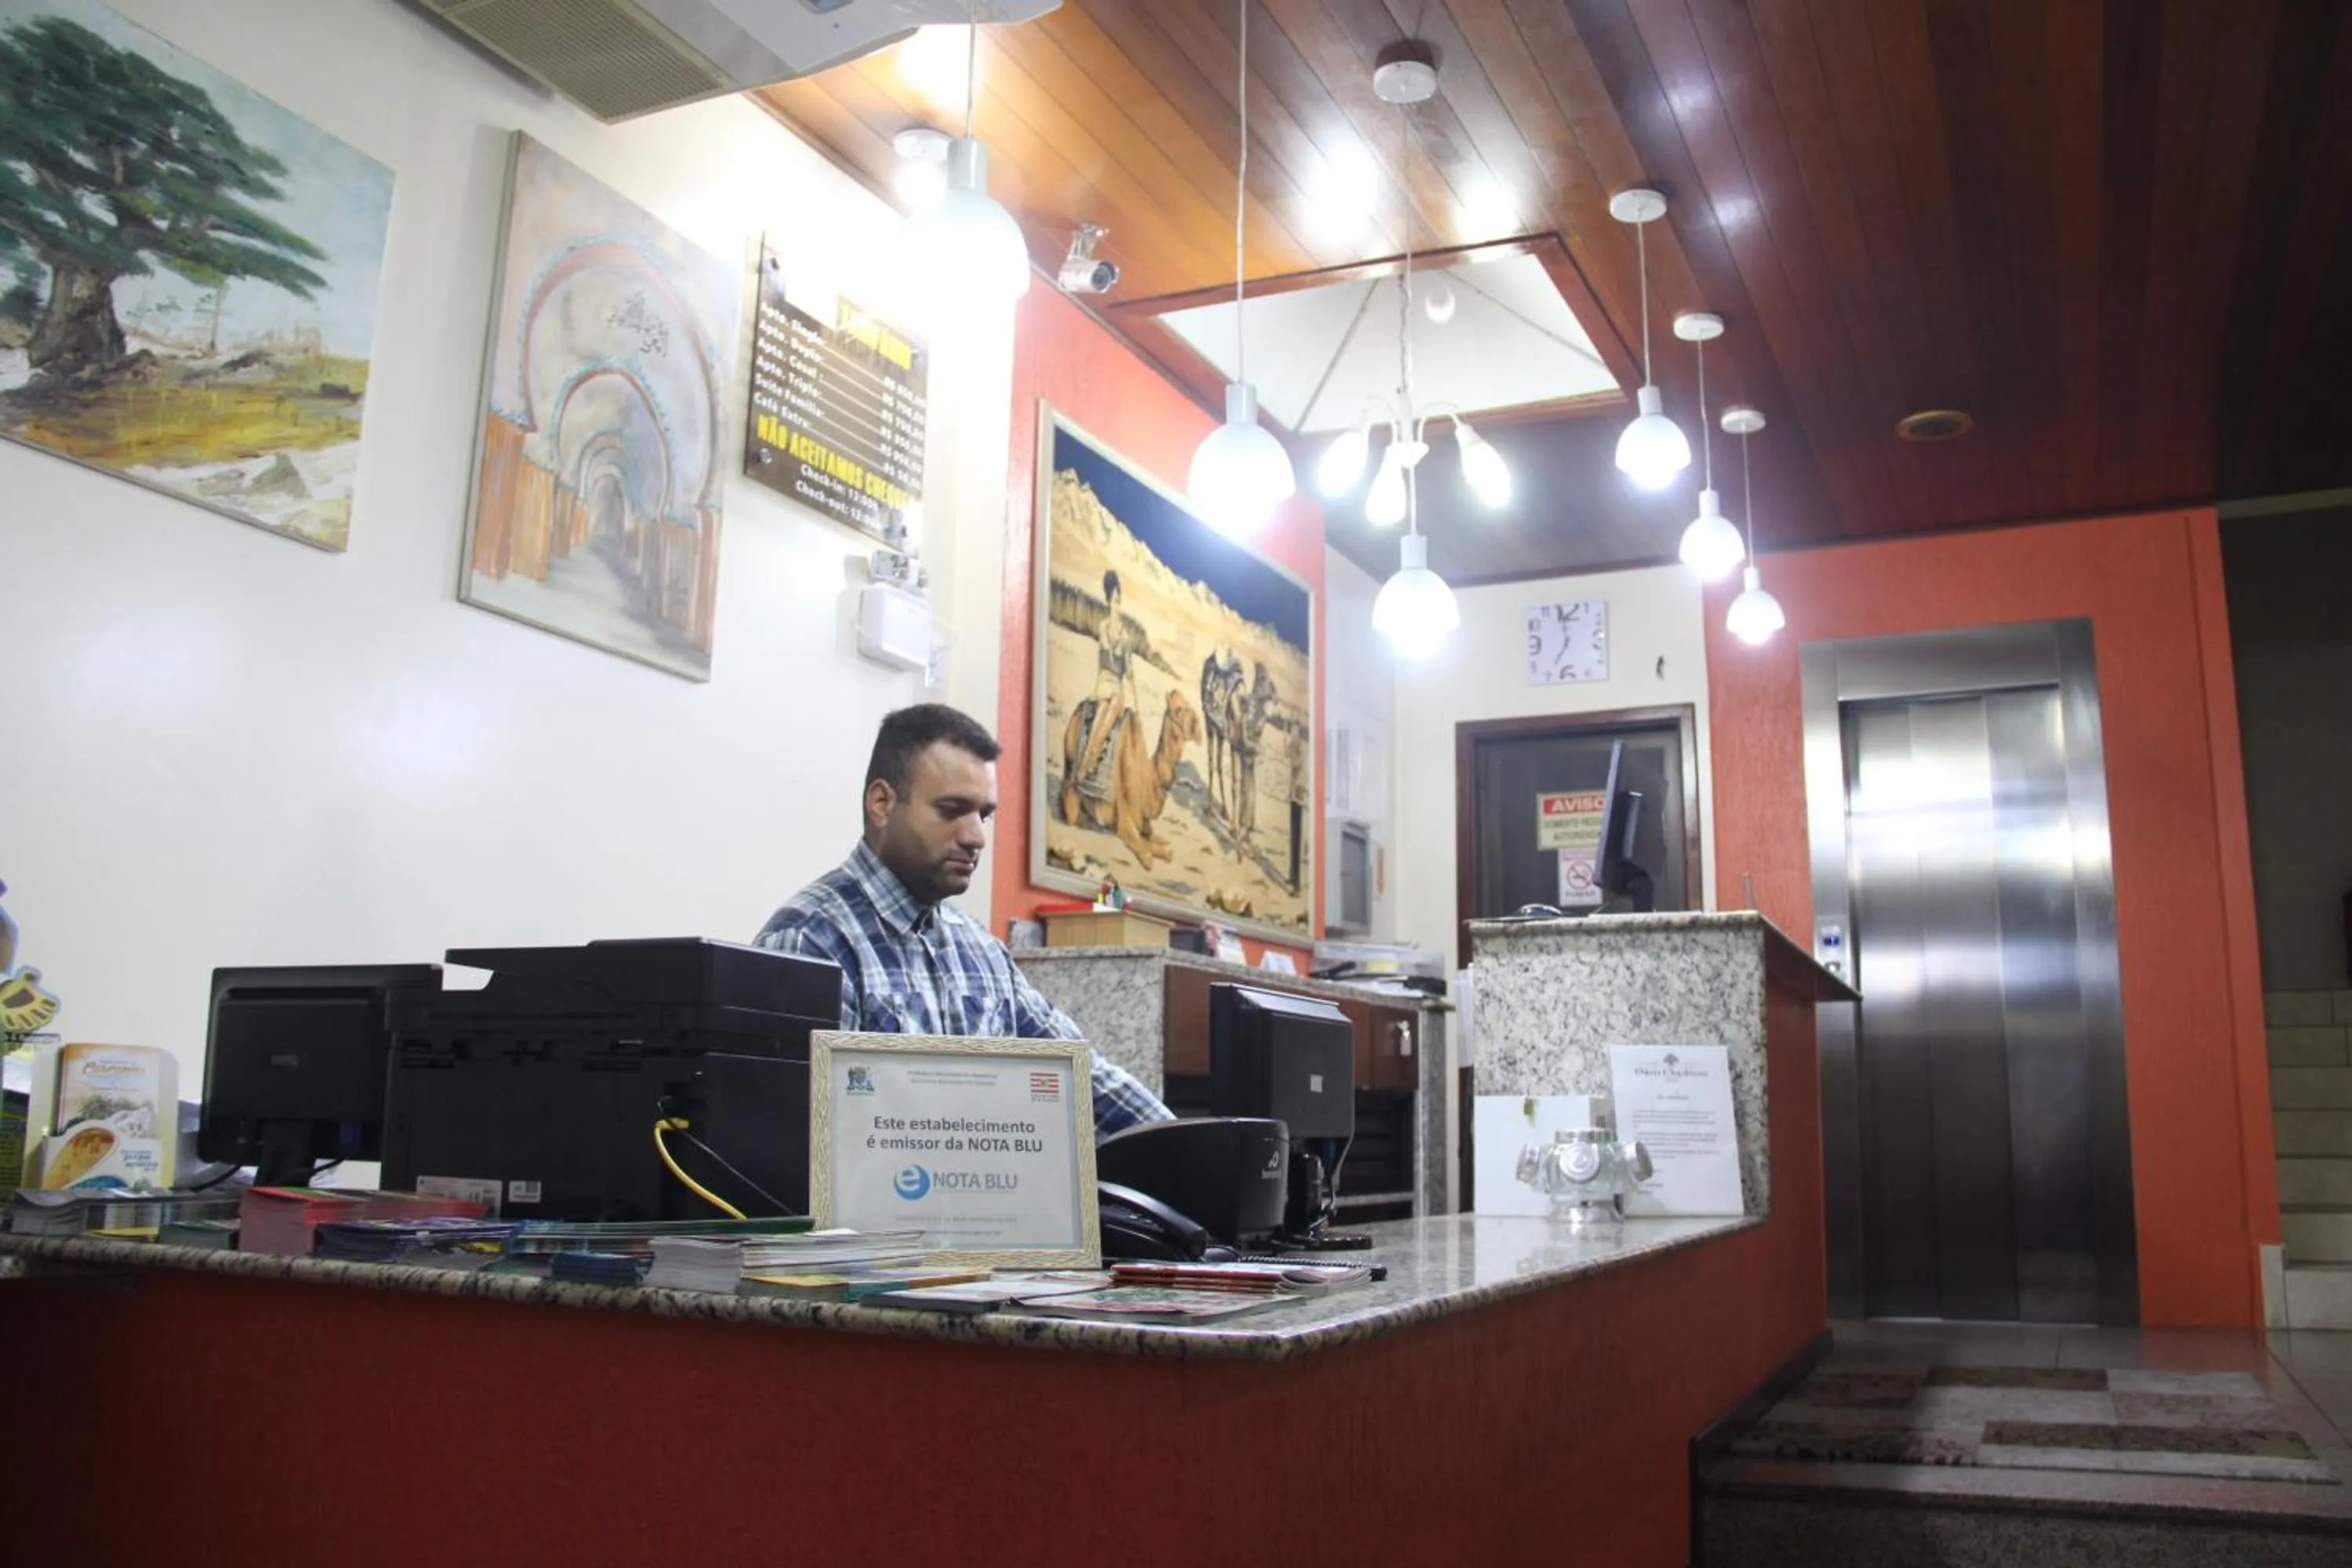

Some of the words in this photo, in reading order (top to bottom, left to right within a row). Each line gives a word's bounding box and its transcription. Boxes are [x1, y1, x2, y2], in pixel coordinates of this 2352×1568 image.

[757, 412, 788, 450] NÃO
[873, 1116, 906, 1131] Este
[909, 1117, 1036, 1134] estabelecimento
[866, 1135, 876, 1149] é
[880, 1136, 941, 1151] emissor
[945, 1137, 964, 1151] da
[967, 1138, 1010, 1152] NOTA
[1014, 1139, 1043, 1153] BLU
[933, 1172, 982, 1189] NOTA
[985, 1174, 1018, 1190] BLU
